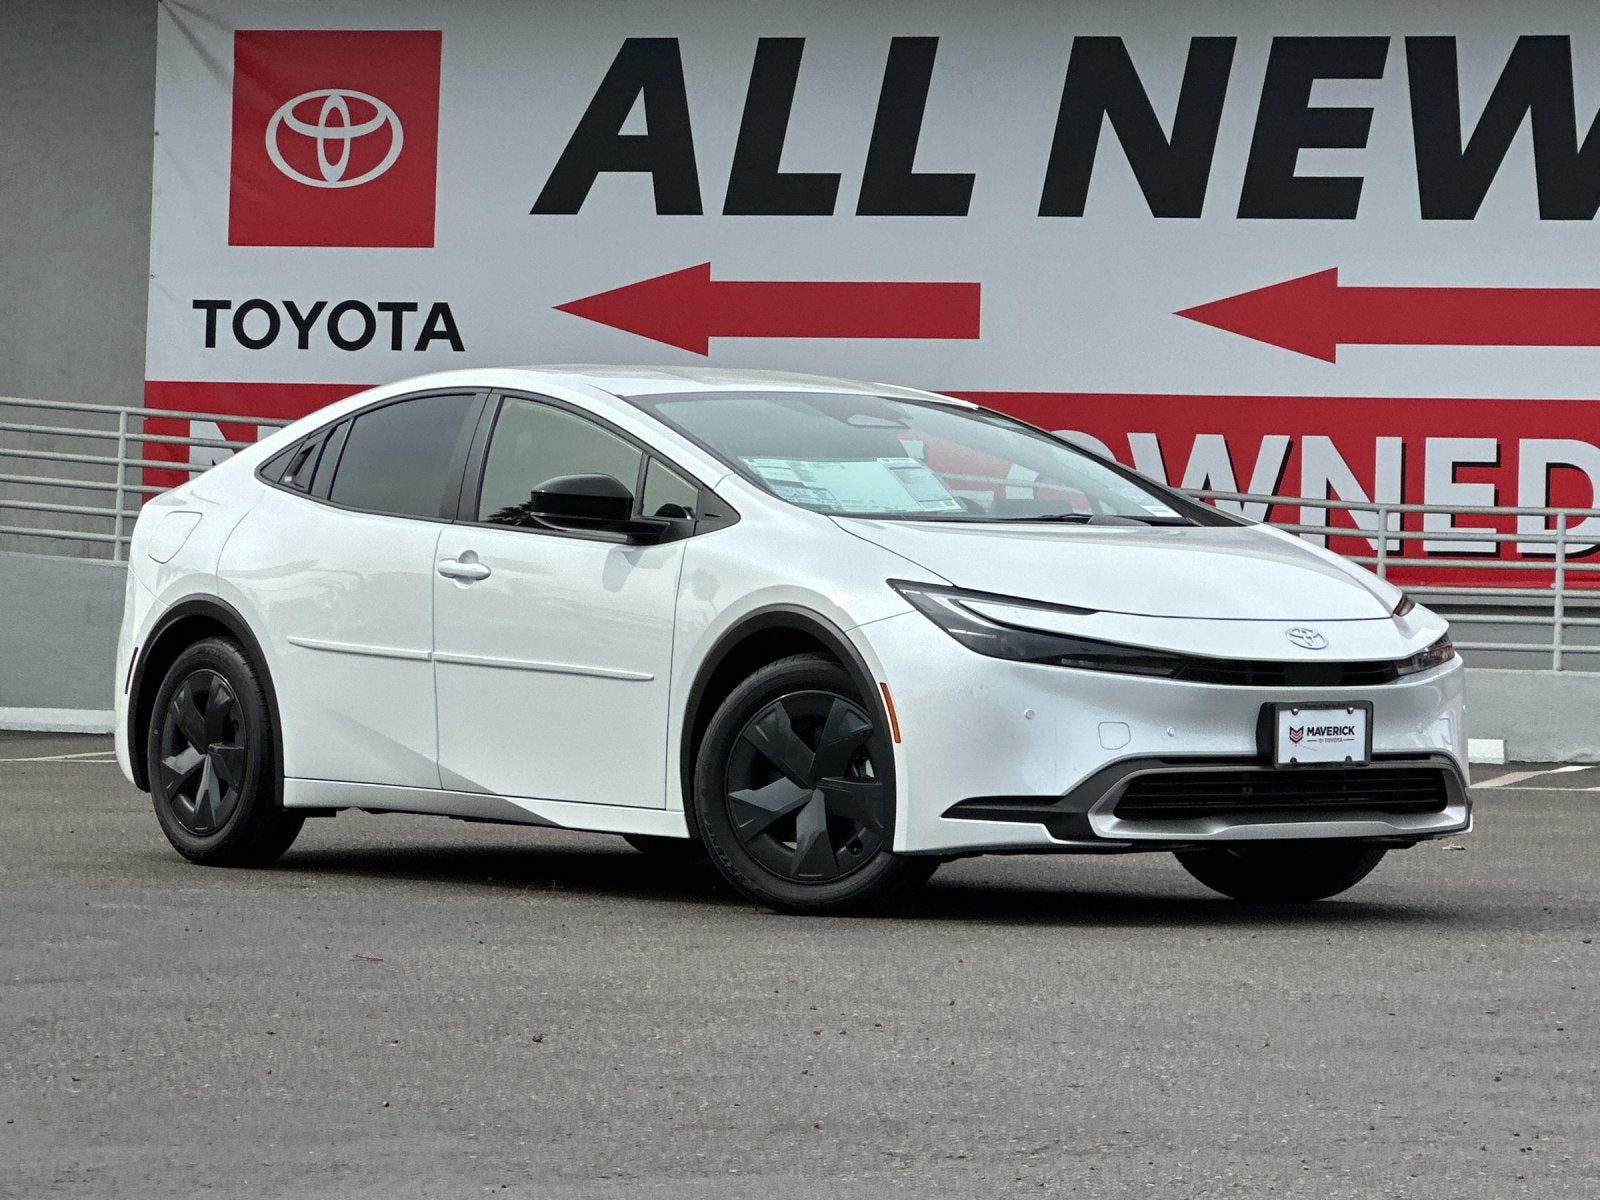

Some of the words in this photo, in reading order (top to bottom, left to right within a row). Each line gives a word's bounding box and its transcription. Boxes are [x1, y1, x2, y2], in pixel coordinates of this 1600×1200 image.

[529, 36, 976, 217] ALL
[1037, 35, 1600, 220] NEW
[192, 298, 466, 352] TOYOTA
[1306, 725, 1355, 736] MAVERICK
